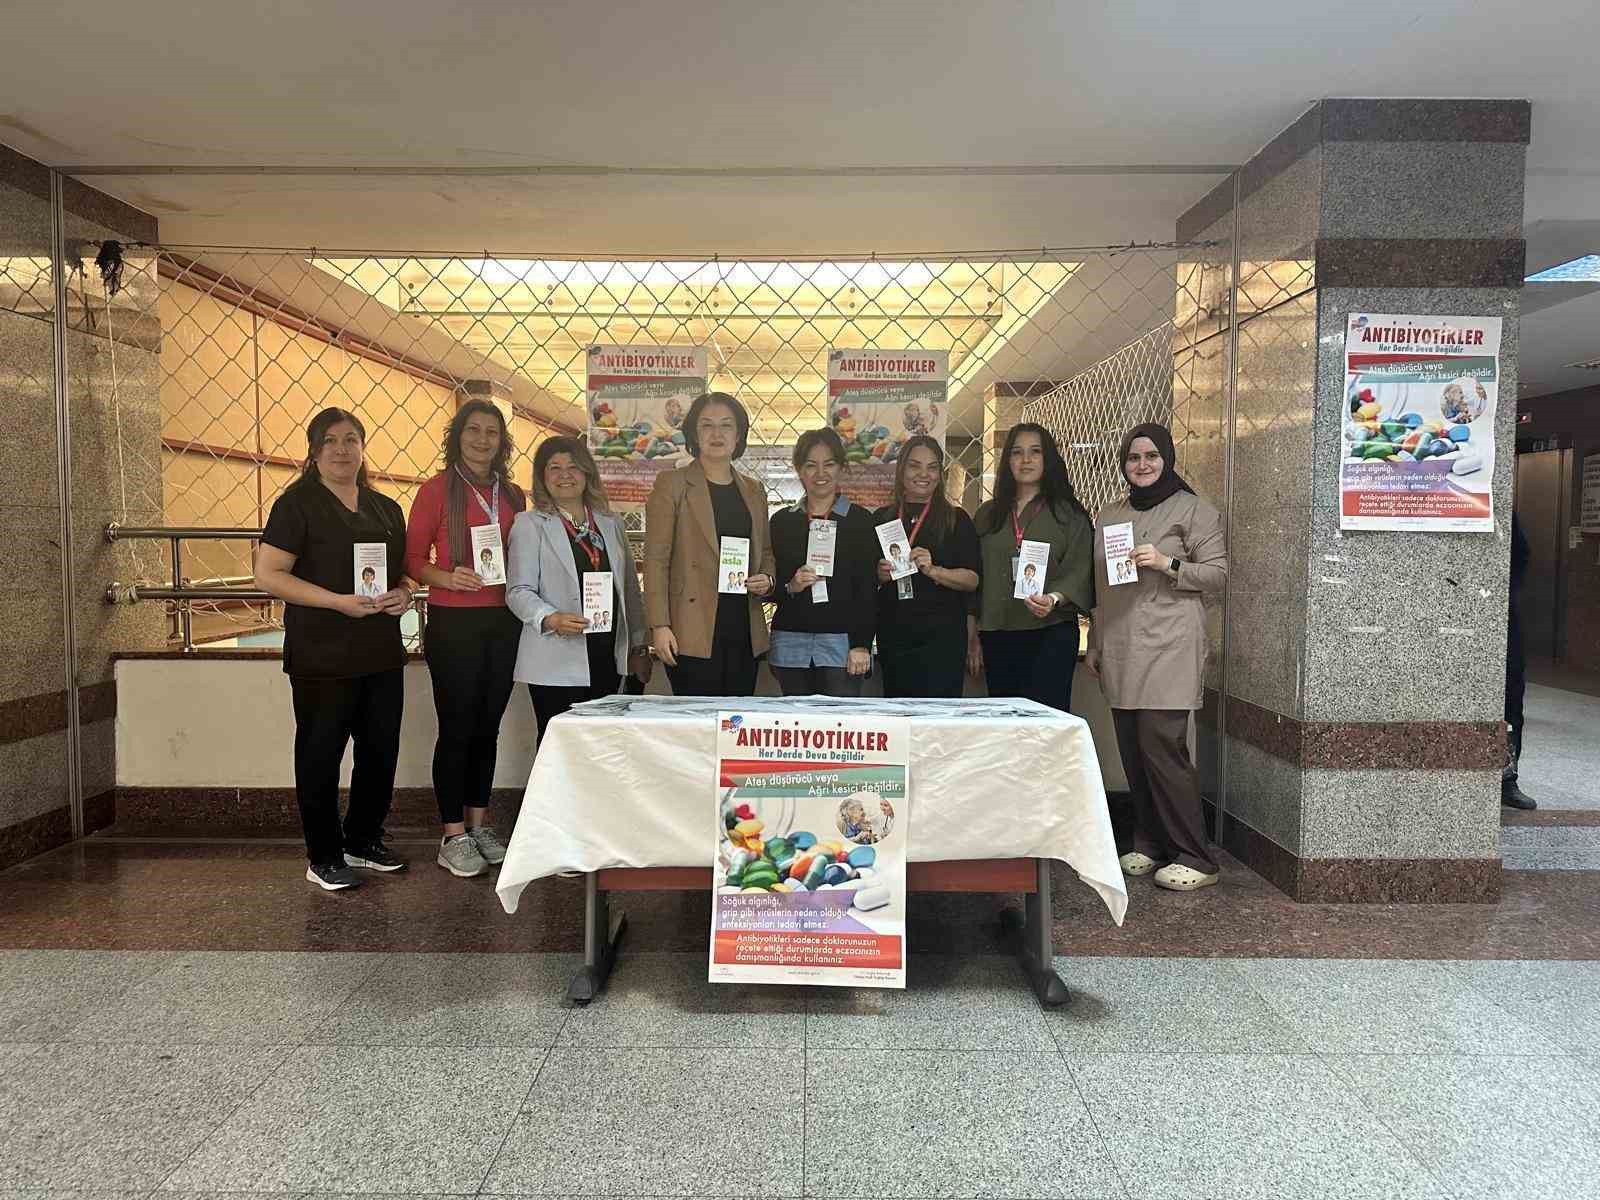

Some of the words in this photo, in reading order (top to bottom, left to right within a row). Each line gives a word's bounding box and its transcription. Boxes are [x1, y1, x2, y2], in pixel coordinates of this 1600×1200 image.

[1362, 321, 1484, 345] ANTİBİYOTİKLER
[598, 350, 696, 368] ANTİBİYOTİKLER
[840, 353, 936, 372] ANTİBİYOTİKLER
[736, 720, 888, 751] ANTİBİYOTİKLER
[758, 748, 773, 758] Her
[777, 749, 802, 759] Derde
[806, 750, 827, 760] Deva
[830, 750, 865, 762] Değildir
[745, 777, 766, 787] Ateş
[770, 774, 812, 786] düşürücü
[815, 773, 838, 784] veya
[808, 786, 829, 796] Ağrı
[832, 782, 859, 793] kesici
[862, 781, 901, 792] değildir.
[722, 896, 746, 906] Soğuk
[748, 896, 782, 907] algınlığı,
[722, 908, 738, 919] grip
[740, 908, 754, 919] gibi
[757, 908, 791, 917] virüslerin
[794, 908, 818, 917] neden
[820, 908, 847, 919] olduğu
[722, 920, 774, 930] enfeksiyonları
[777, 920, 801, 929] tedavi
[804, 921, 829, 929] etmez.
[736, 934, 790, 944] Antibiyotikleri
[793, 936, 820, 944] sadece
[822, 936, 877, 946] doktorunuzun
[736, 944, 760, 953] reçete
[763, 945, 783, 955] ettiği
[786, 944, 832, 954] durumlarda
[836, 948, 880, 956] eczacınızın
[736, 954, 802, 964] danışmanlığında
